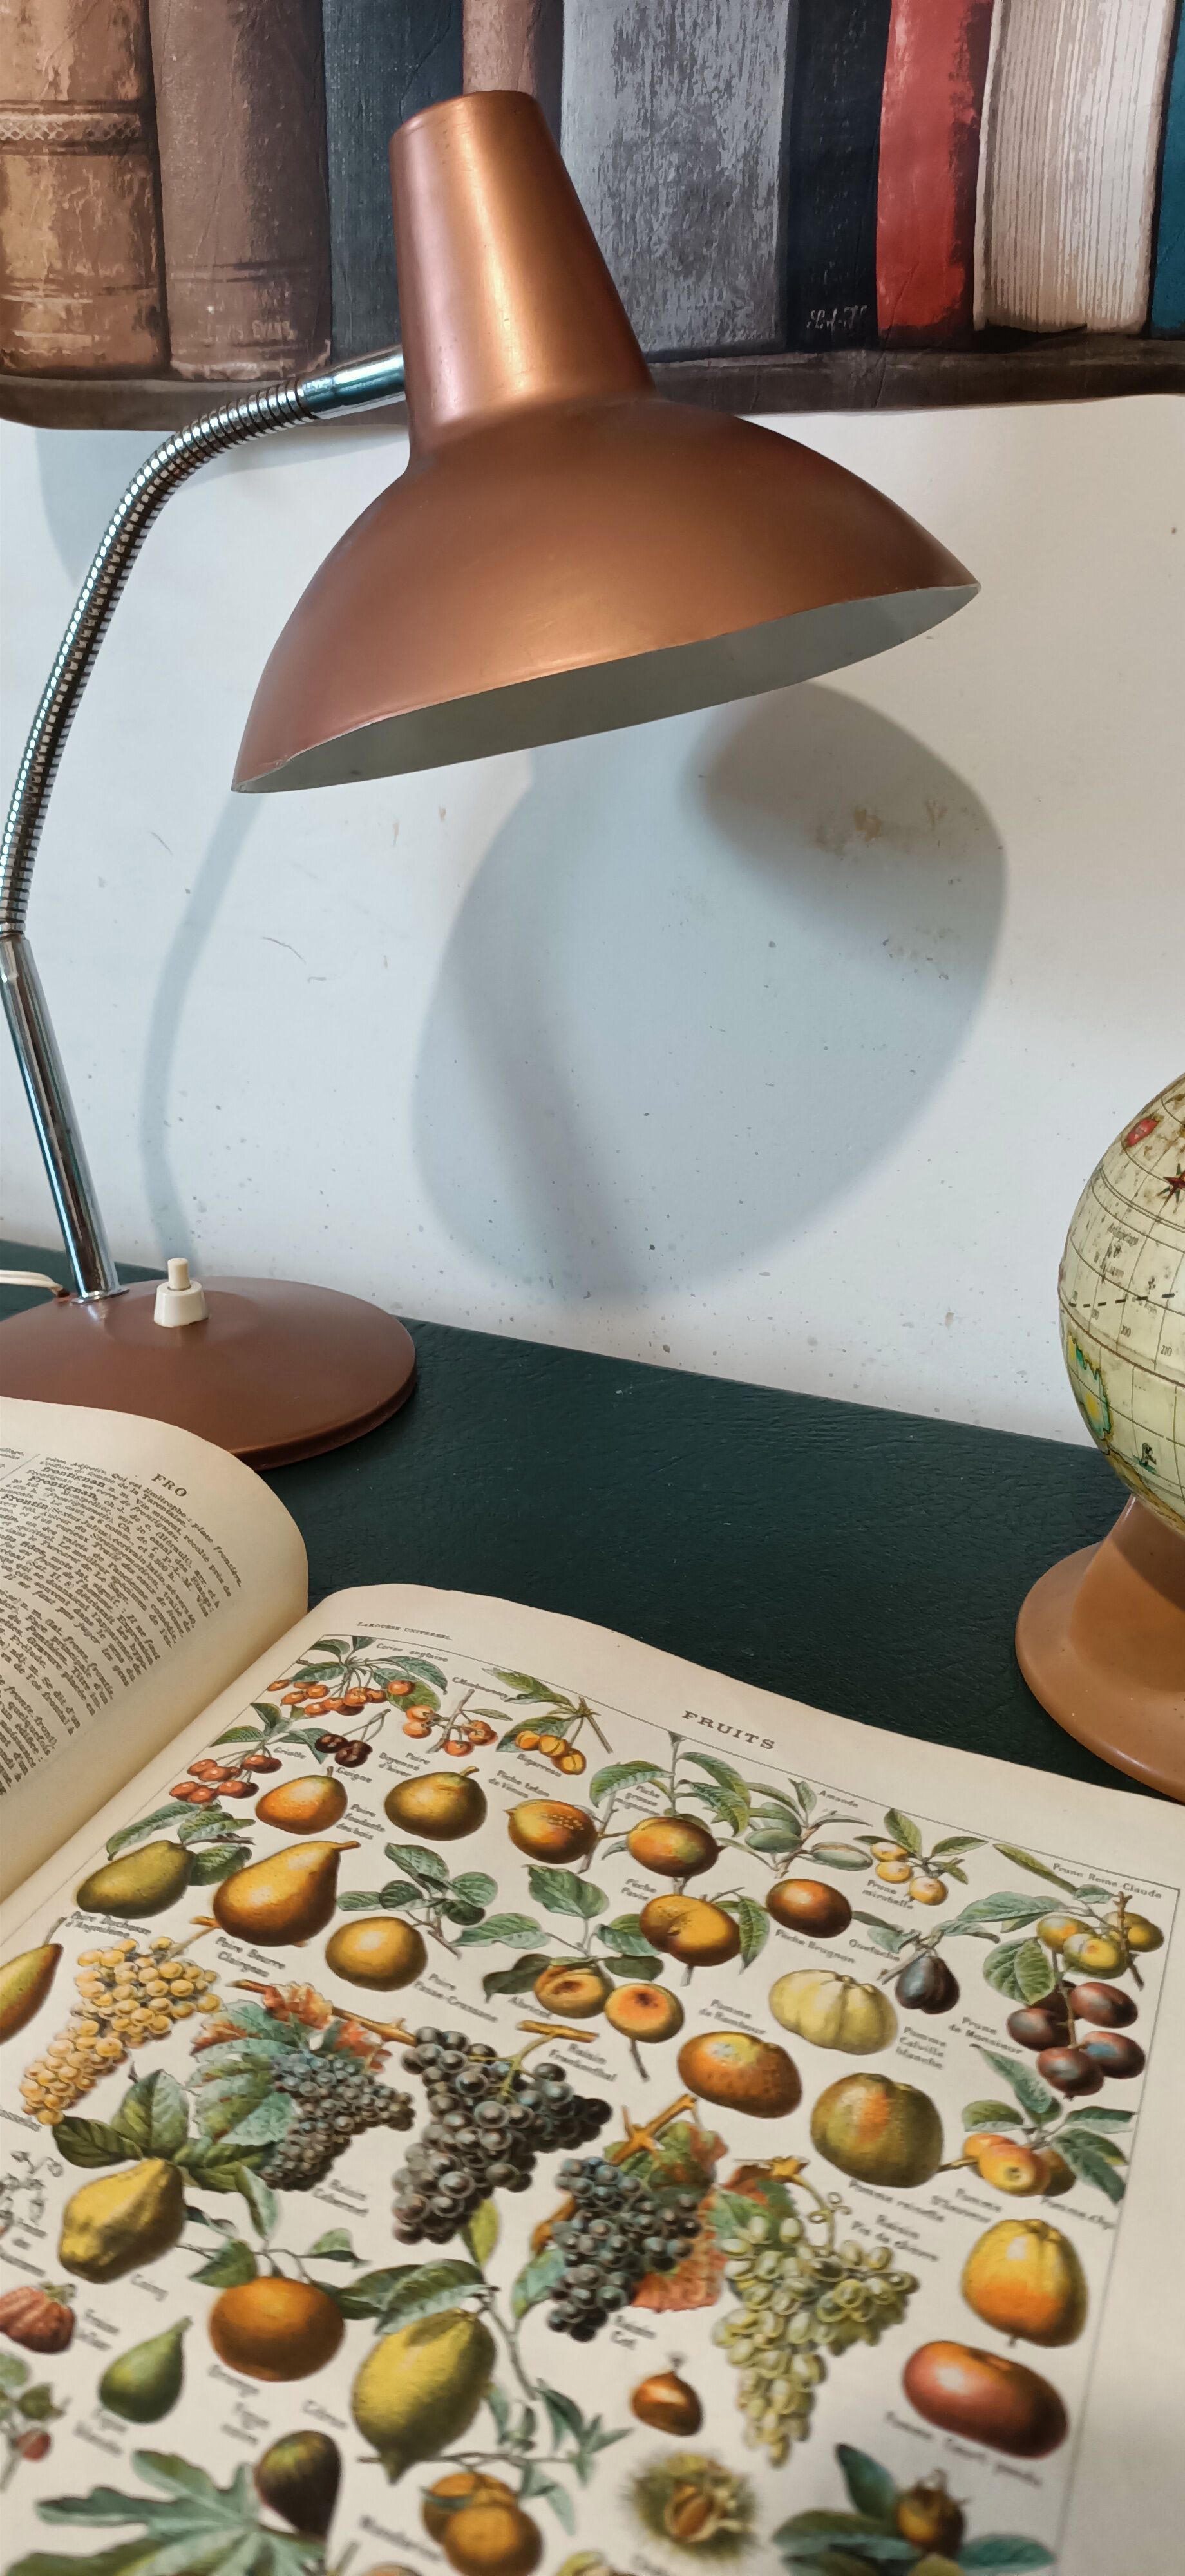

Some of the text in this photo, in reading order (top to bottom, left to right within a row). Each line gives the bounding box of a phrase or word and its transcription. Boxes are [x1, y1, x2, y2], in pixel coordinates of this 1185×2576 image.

[151, 1473, 187, 1497] FRO
[1, 1491, 48, 1513] Frontin
[191, 1523, 213, 1543] place
[58, 1541, 71, 1550] Le
[149, 1537, 188, 1573] canal des
[94, 1571, 106, 1582] Le
[183, 1621, 191, 1633] de
[27, 1637, 62, 1670] Gravure
[112, 1665, 129, 1687] gens
[41, 1677, 53, 1689] Se
[53, 1690, 66, 1705] dit
[8, 1701, 50, 1756] quelquefois
[681, 1710, 776, 1750] FRUITS
[1053, 1863, 1083, 1877] Prune
